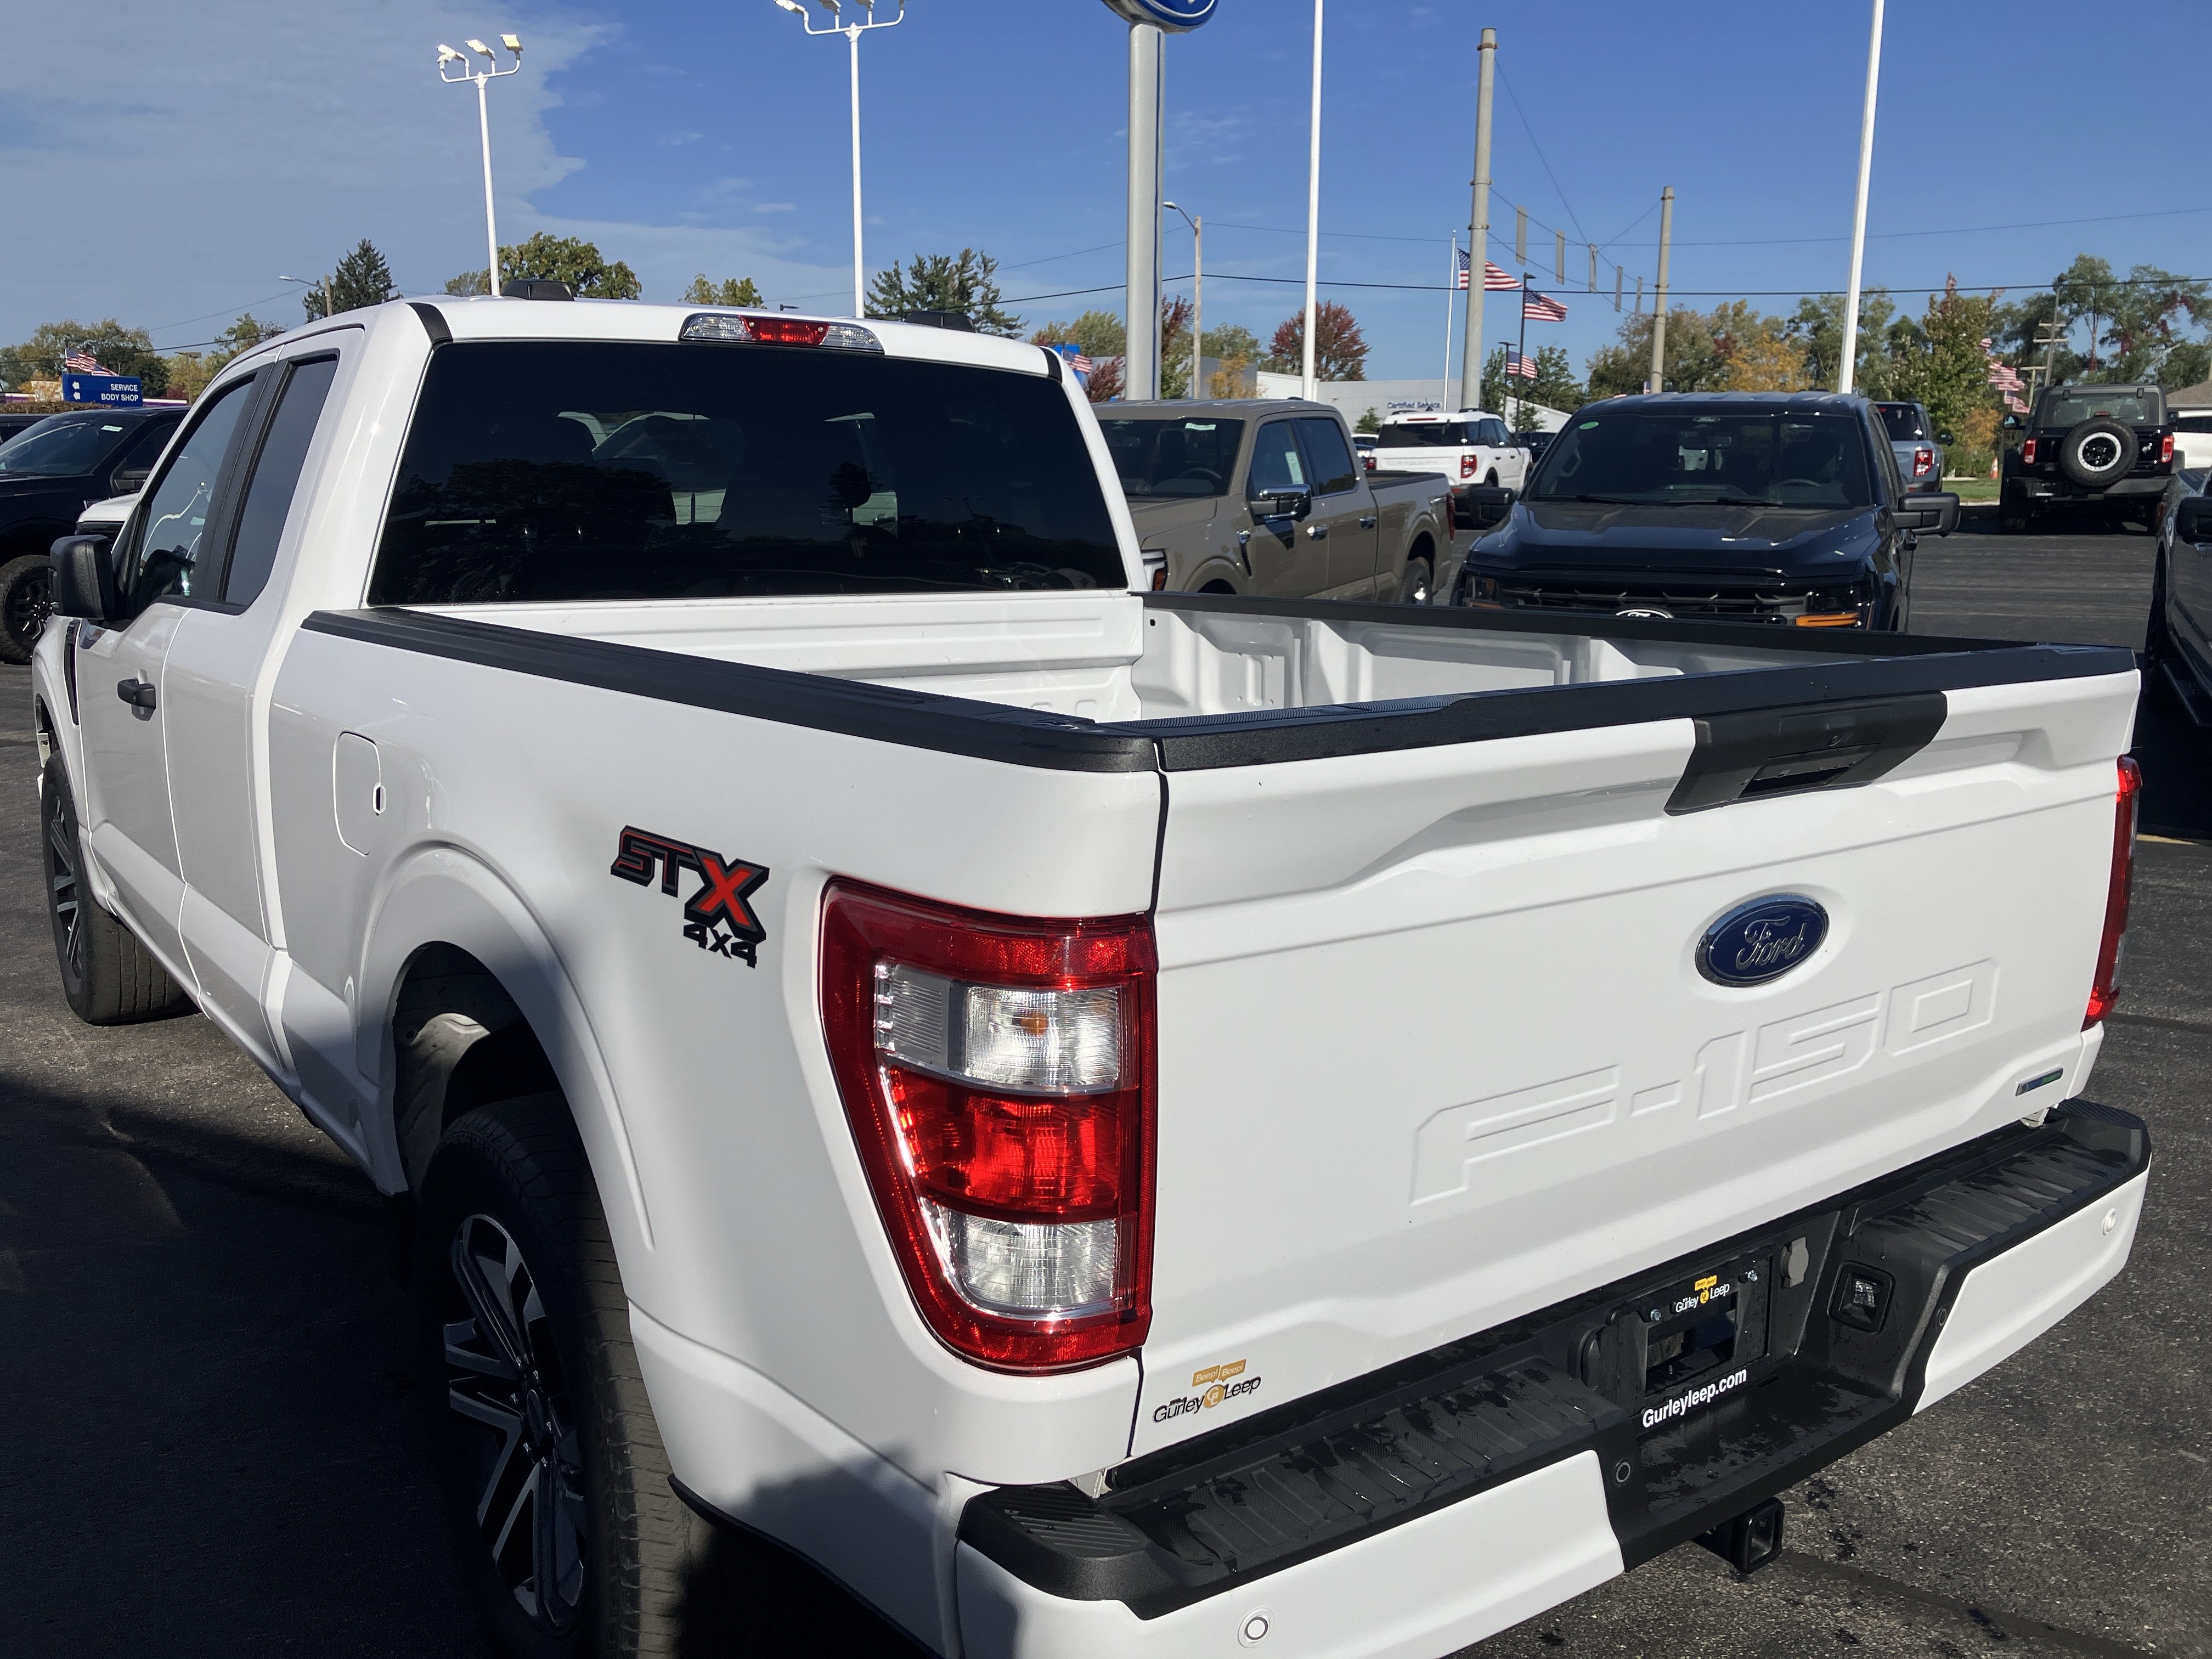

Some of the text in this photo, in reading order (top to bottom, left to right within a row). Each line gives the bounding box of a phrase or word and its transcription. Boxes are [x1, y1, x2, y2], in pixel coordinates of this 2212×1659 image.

[110, 383, 138, 392] SERVICE
[611, 825, 770, 945] STX
[1735, 915, 1808, 970] Ford
[1410, 957, 2000, 1206] F-150
[1675, 1296, 1699, 1313] Gurley
[1710, 1283, 1730, 1299] Leep
[1195, 1363, 1244, 1383] Beep! Beep!
[1642, 1369, 1747, 1428] Gurleyleep.com
[1153, 1395, 1206, 1423] Gurley
[1223, 1376, 1261, 1400] Leep
